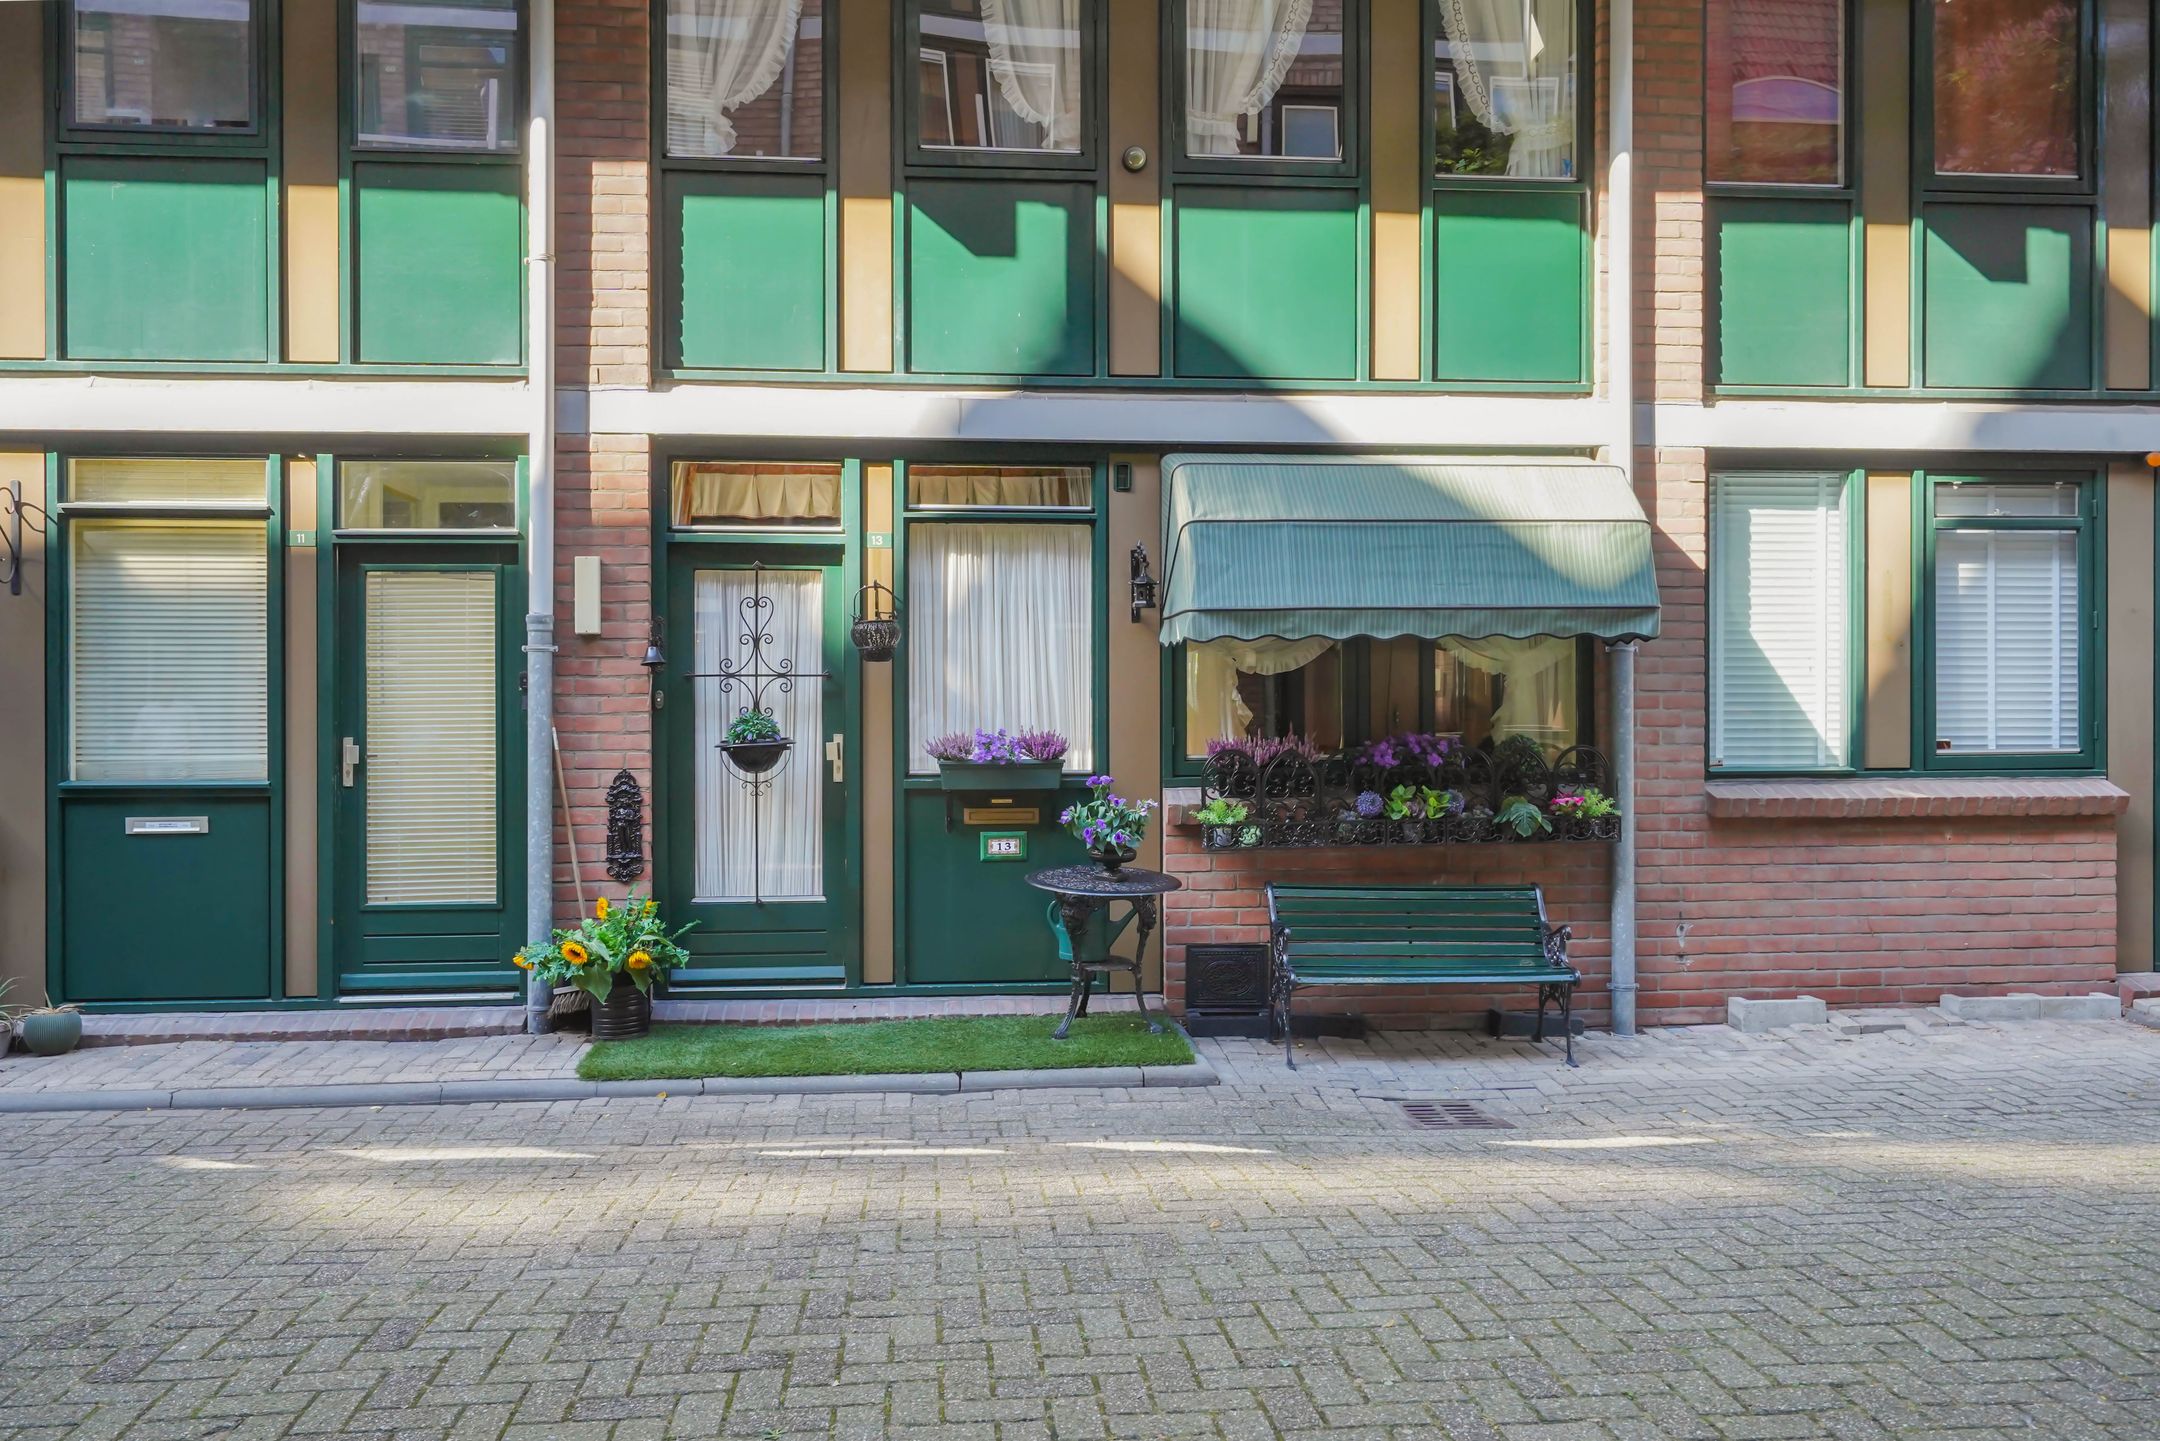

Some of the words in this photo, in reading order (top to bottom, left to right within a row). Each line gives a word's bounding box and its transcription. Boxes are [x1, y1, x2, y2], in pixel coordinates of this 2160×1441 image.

[296, 533, 305, 544] 11
[871, 535, 883, 546] 13
[997, 842, 1012, 851] 13
